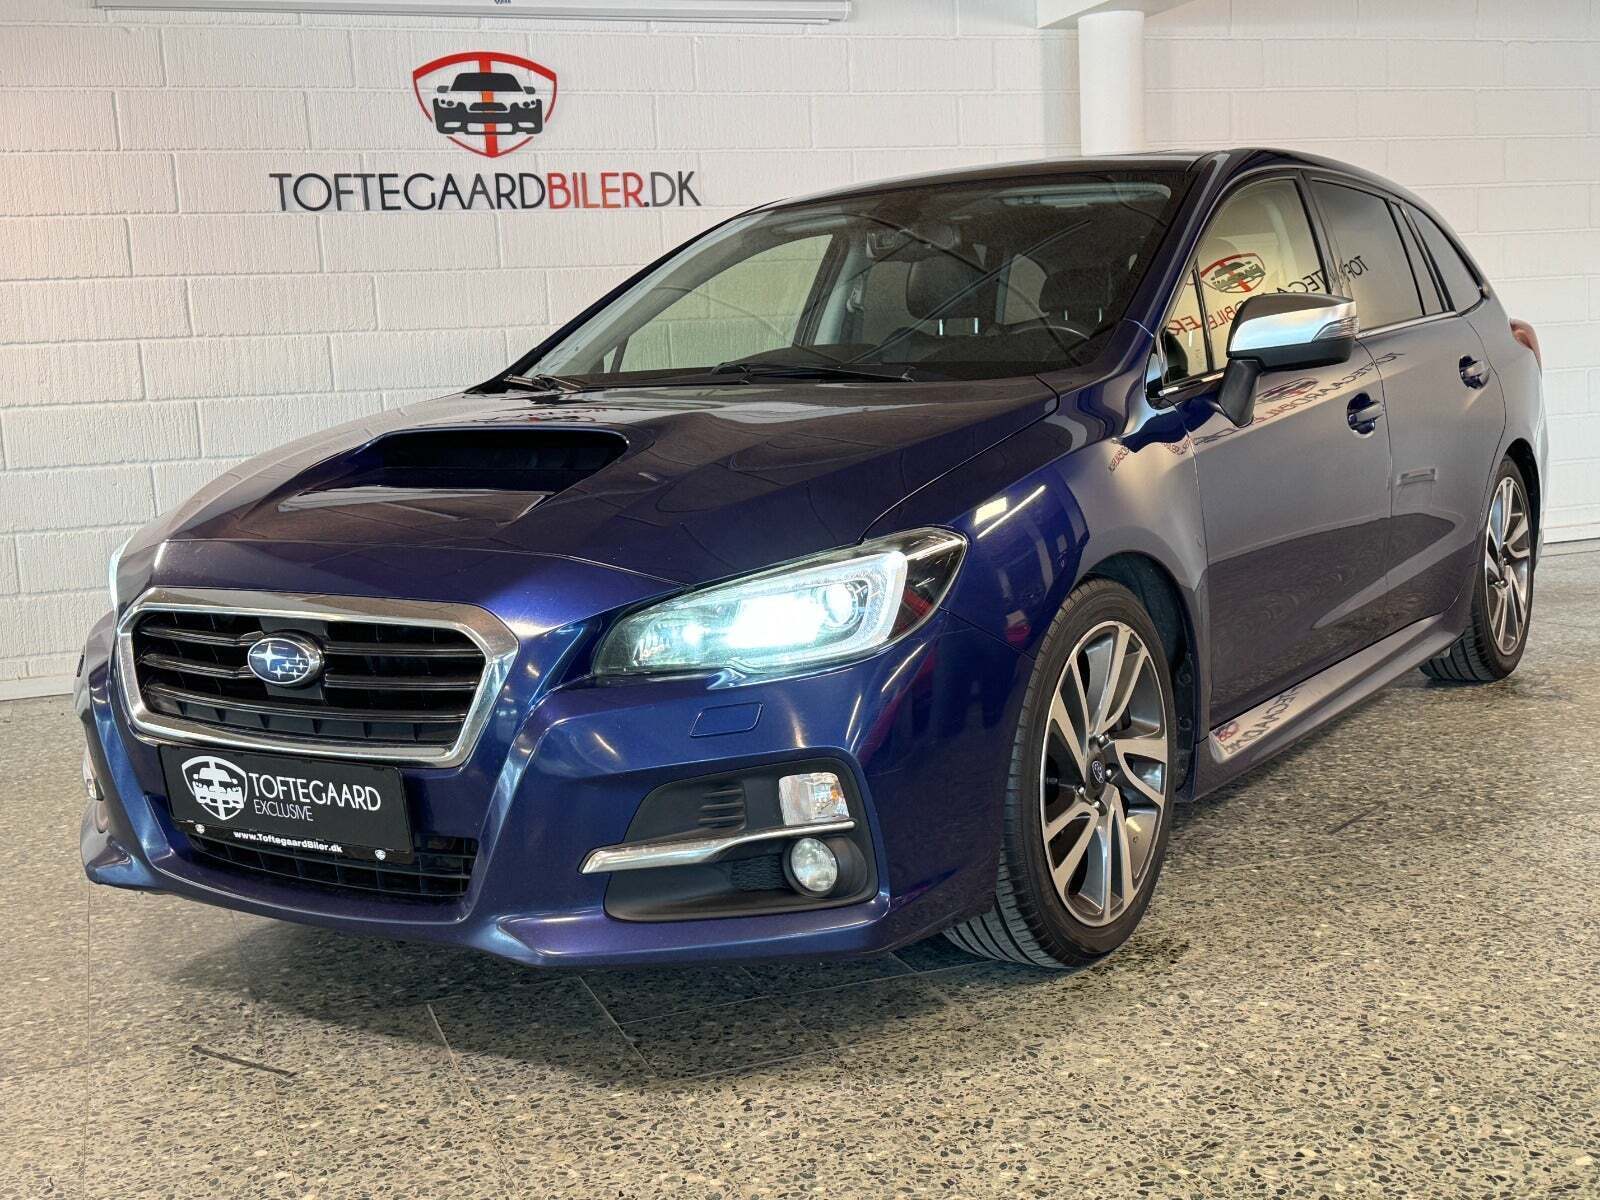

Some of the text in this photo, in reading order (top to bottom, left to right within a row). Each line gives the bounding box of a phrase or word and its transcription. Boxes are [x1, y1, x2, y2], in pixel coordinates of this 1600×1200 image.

[269, 171, 702, 212] TOFTEGAARDBILER.DK
[248, 772, 382, 812] TOFTEGAARD
[254, 799, 314, 822] EXCLUSIVE
[232, 830, 344, 854] www.ToftegaardBiler.dk
